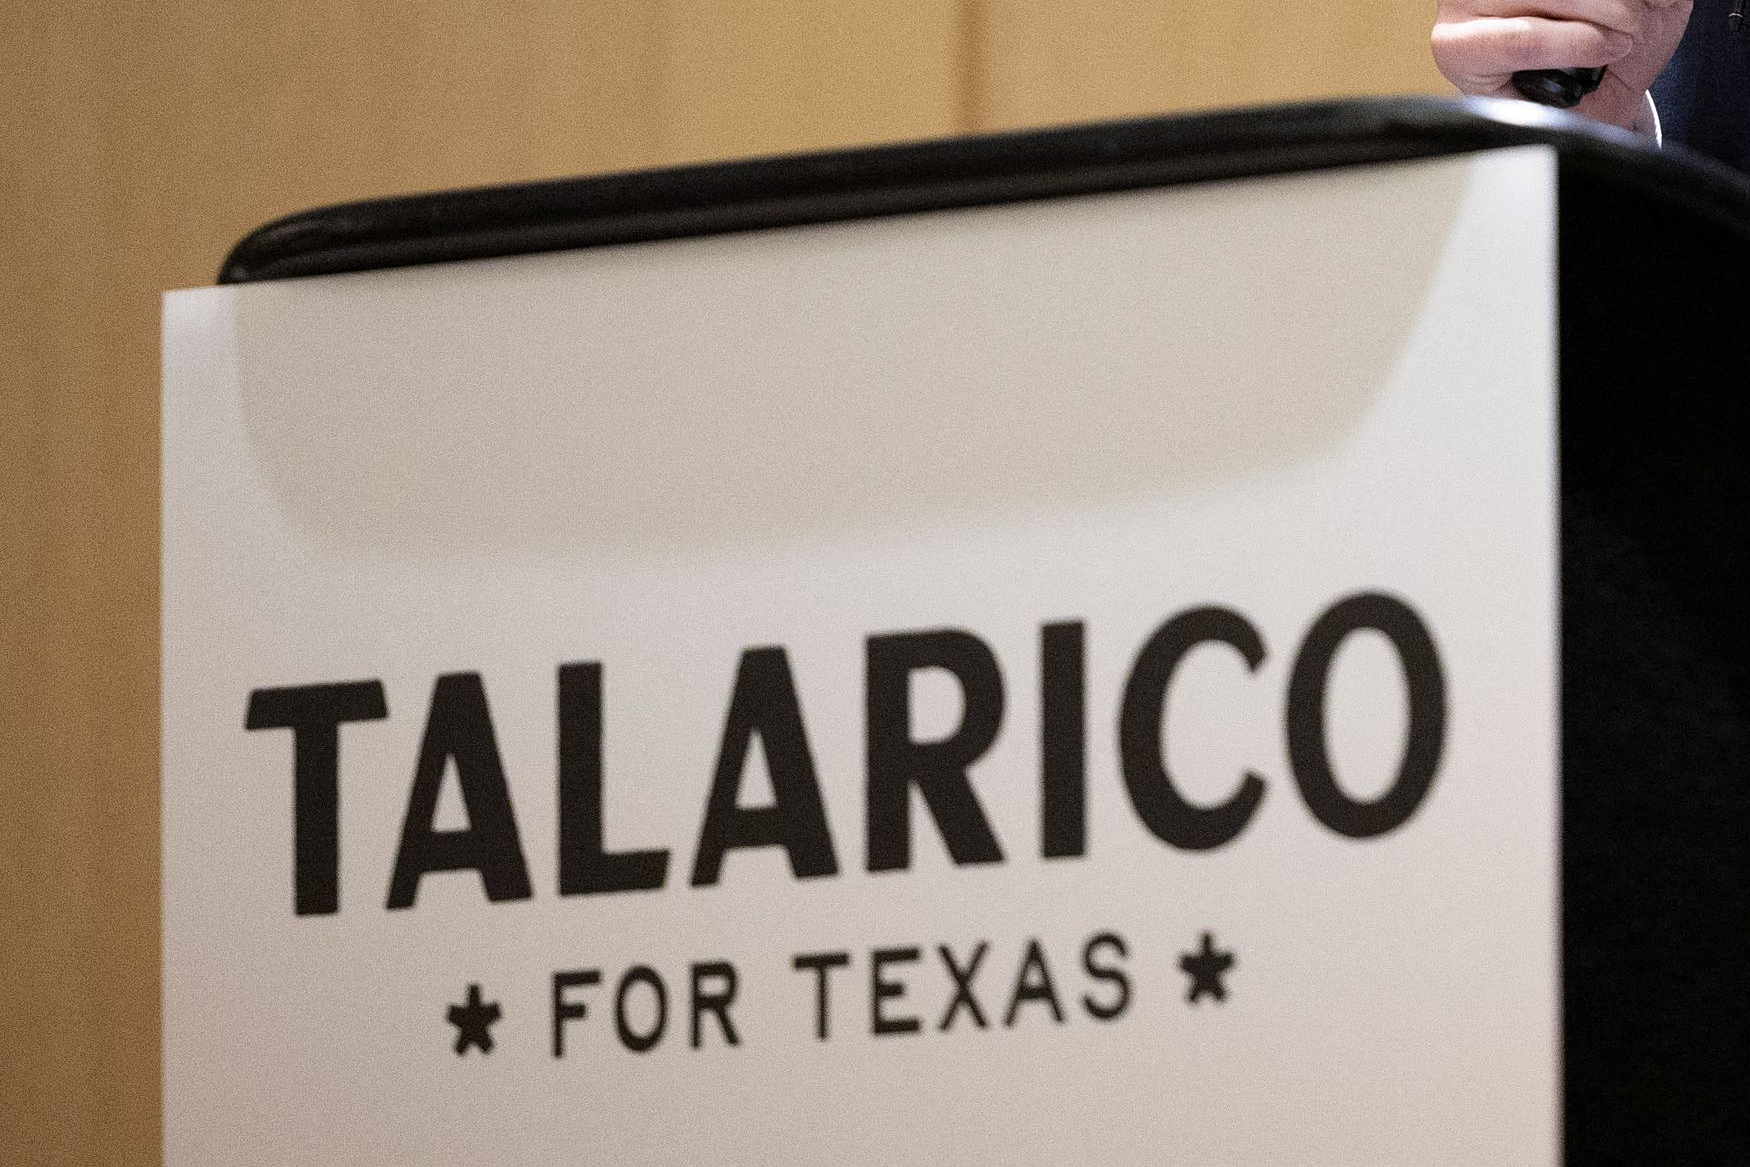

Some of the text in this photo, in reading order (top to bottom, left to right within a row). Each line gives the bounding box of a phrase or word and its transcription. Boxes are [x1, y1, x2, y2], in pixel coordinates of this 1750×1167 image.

[243, 590, 1449, 918] TALARICO
[551, 931, 1133, 1059] FOR TEXAS
